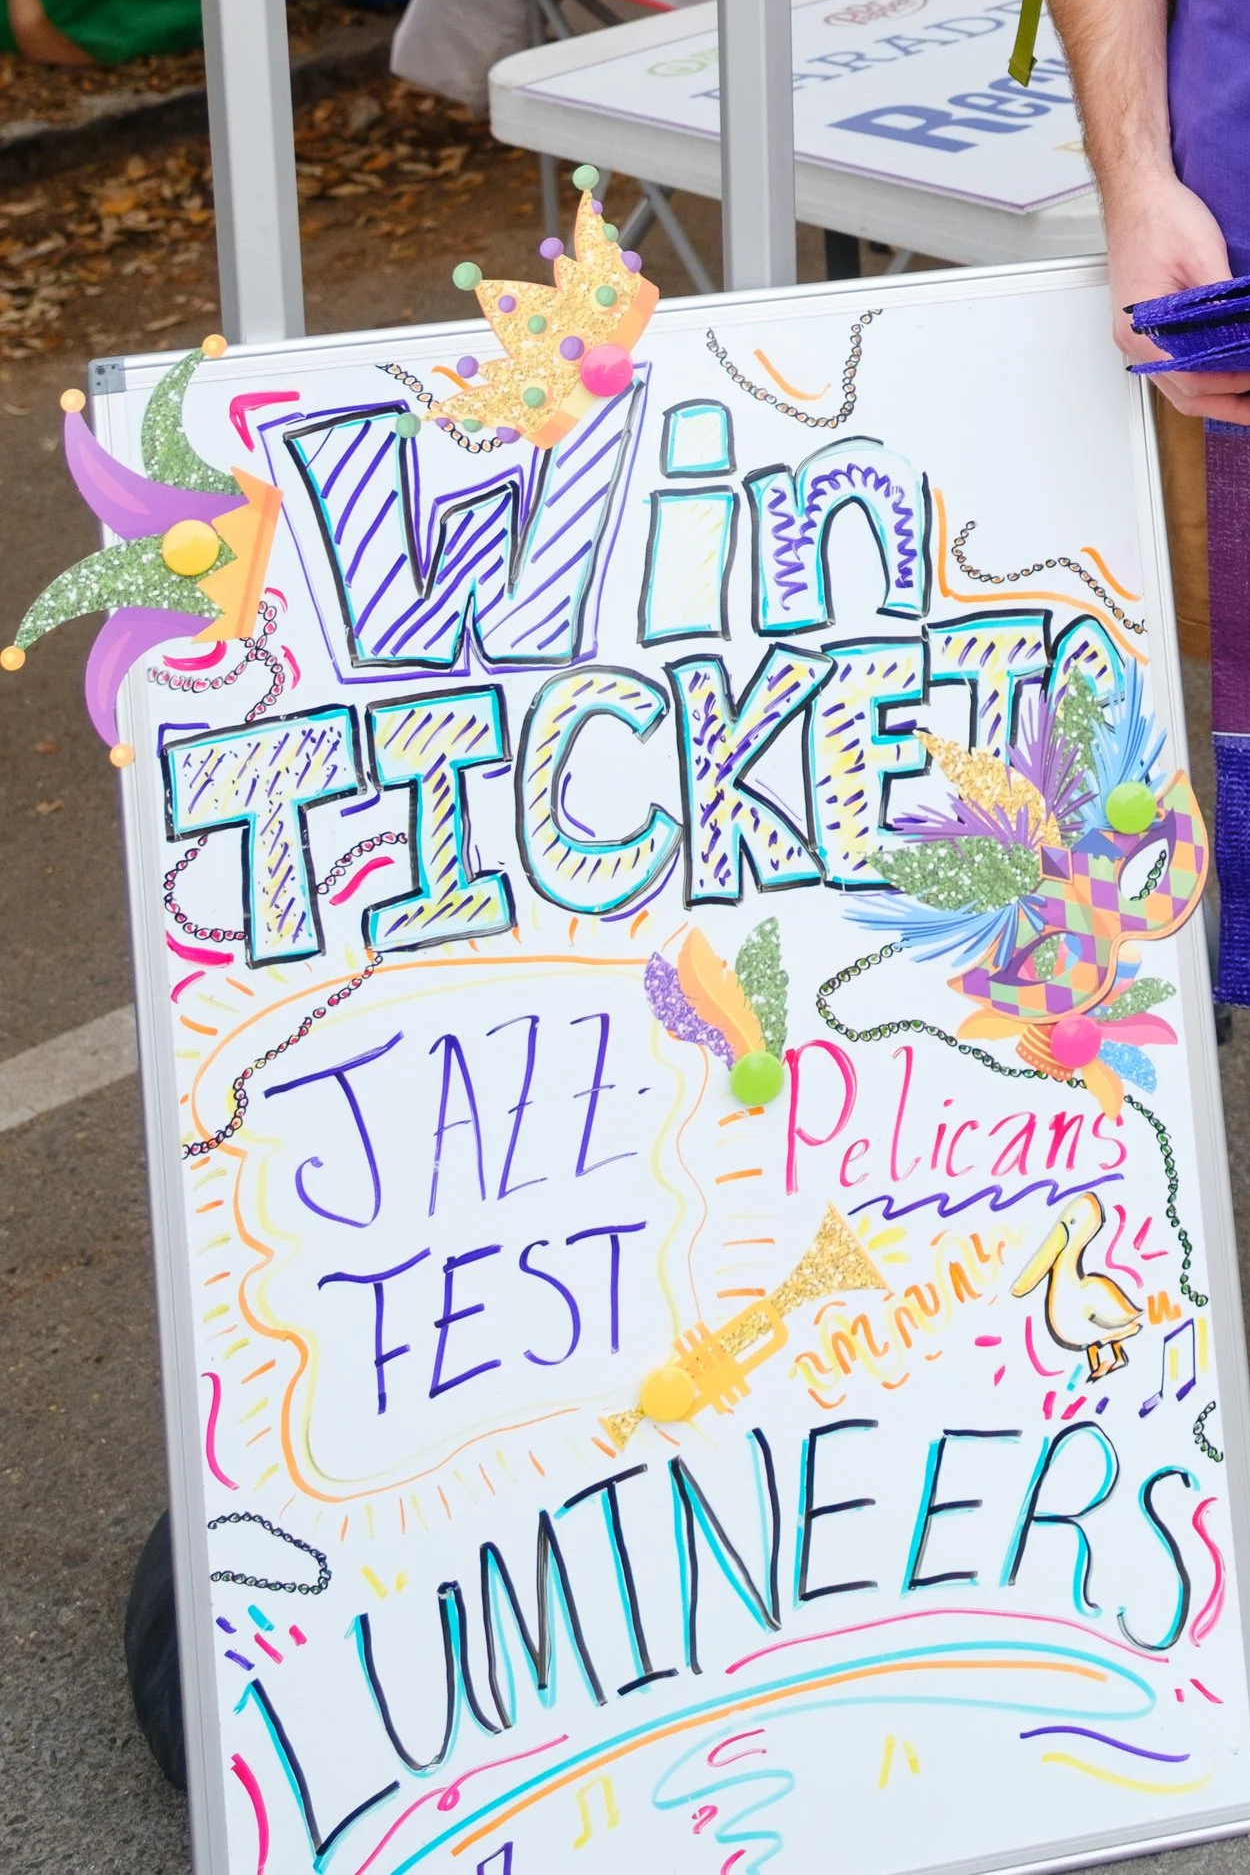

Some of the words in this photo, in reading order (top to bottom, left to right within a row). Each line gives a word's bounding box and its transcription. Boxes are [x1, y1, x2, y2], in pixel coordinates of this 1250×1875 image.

[259, 362, 931, 683] Win
[264, 1012, 648, 1228] JAZZ
[783, 1038, 1128, 1196] Pelicans
[317, 1220, 649, 1415] FEST
[233, 1416, 1192, 1873] LUMINEERS
